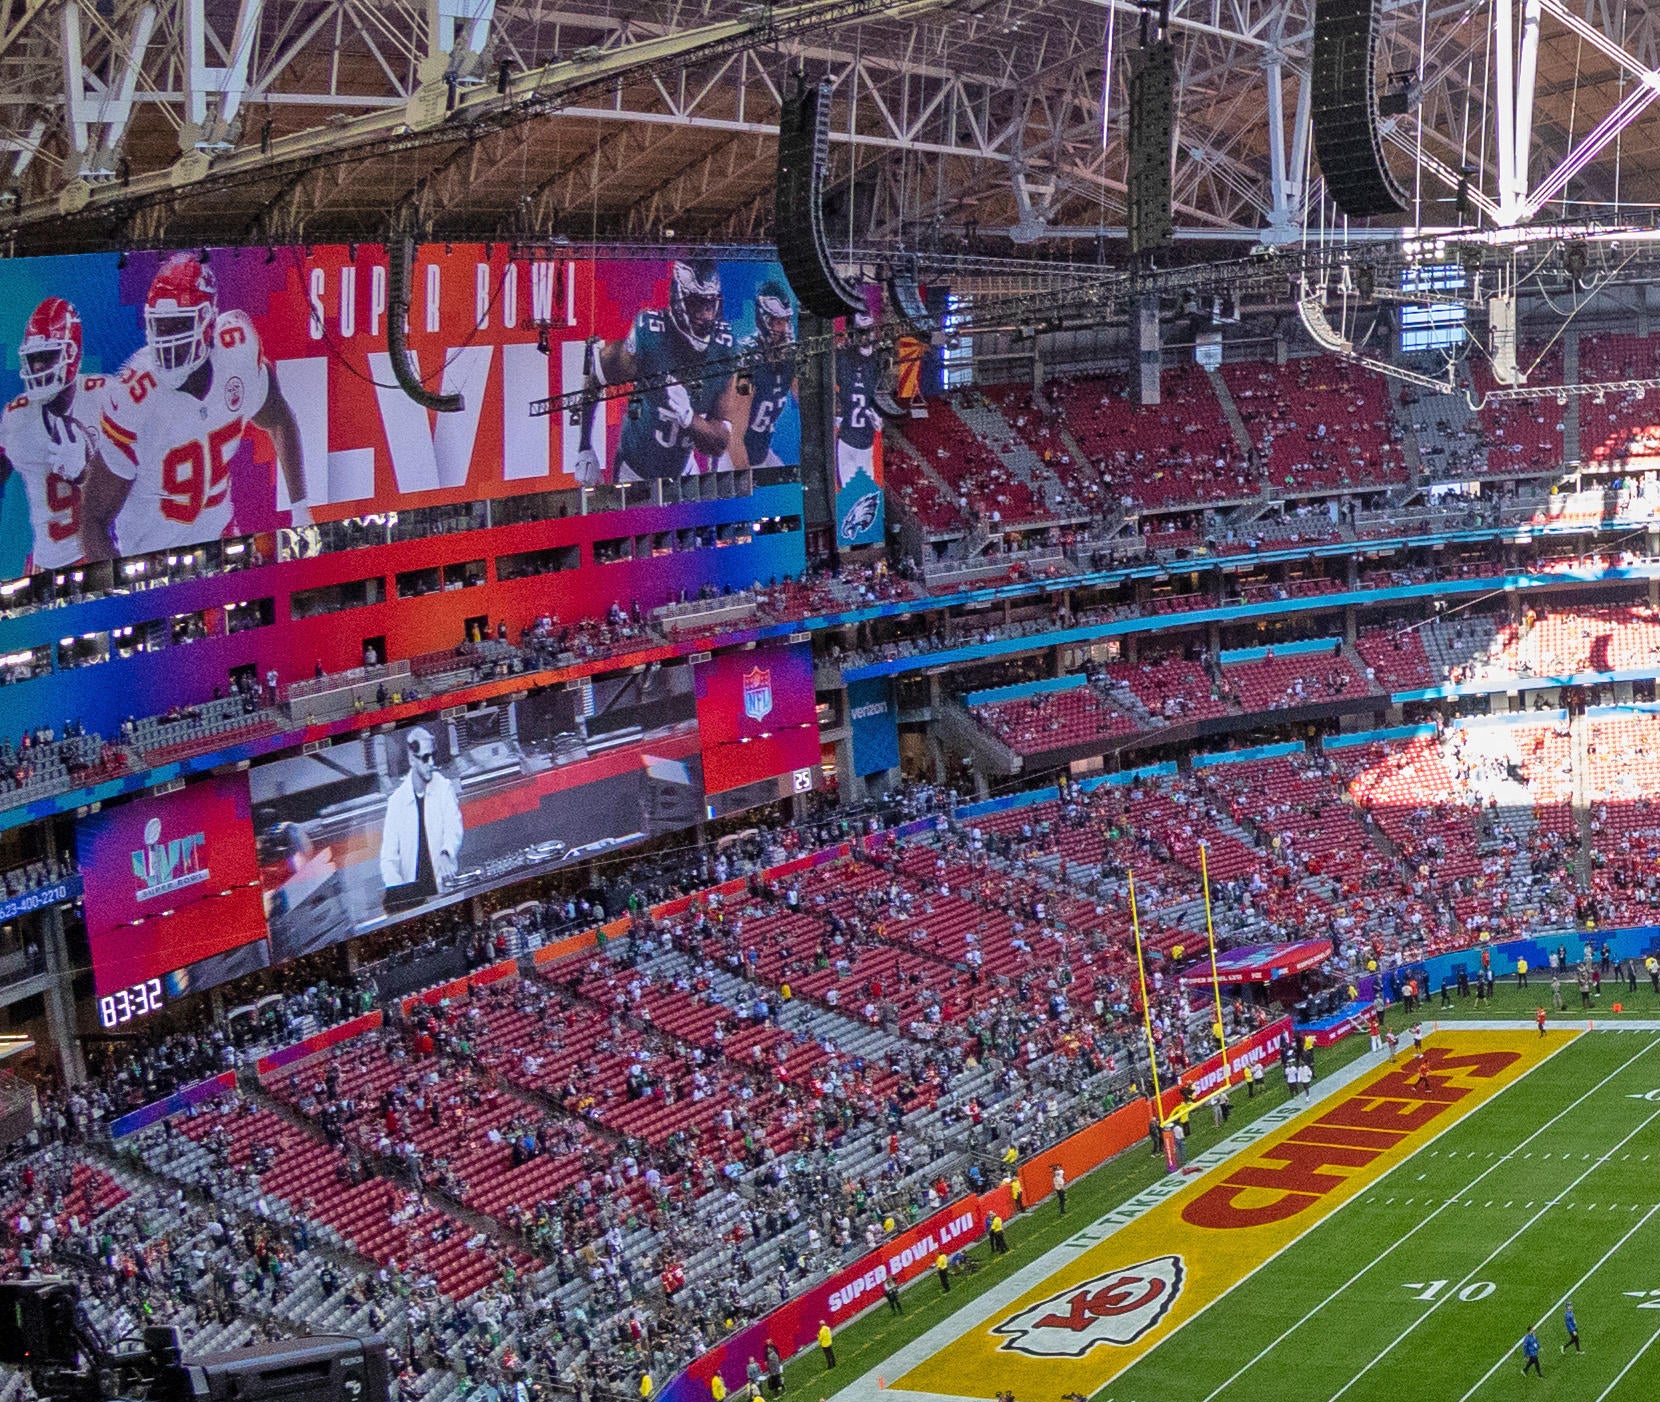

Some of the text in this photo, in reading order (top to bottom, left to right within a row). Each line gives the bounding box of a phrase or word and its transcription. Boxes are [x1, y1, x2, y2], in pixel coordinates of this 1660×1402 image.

[309, 262, 577, 340] SUPR BOWL
[276, 340, 606, 511] LVII
[160, 416, 244, 525] 95
[851, 702, 887, 719] verizon
[794, 771, 811, 791] 25
[101, 978, 163, 1027] 83:32
[1182, 1047, 1523, 1229] CHIEFS
[1065, 1233, 1101, 1249] IT
[1098, 1179, 1187, 1226] TAKES
[1231, 1128, 1268, 1143] OF
[1263, 1107, 1301, 1123] US
[828, 1212, 973, 1312] SUPER BOWL LVII
[1412, 1280, 1497, 1301] 10
[1032, 1277, 1166, 1332] KC
